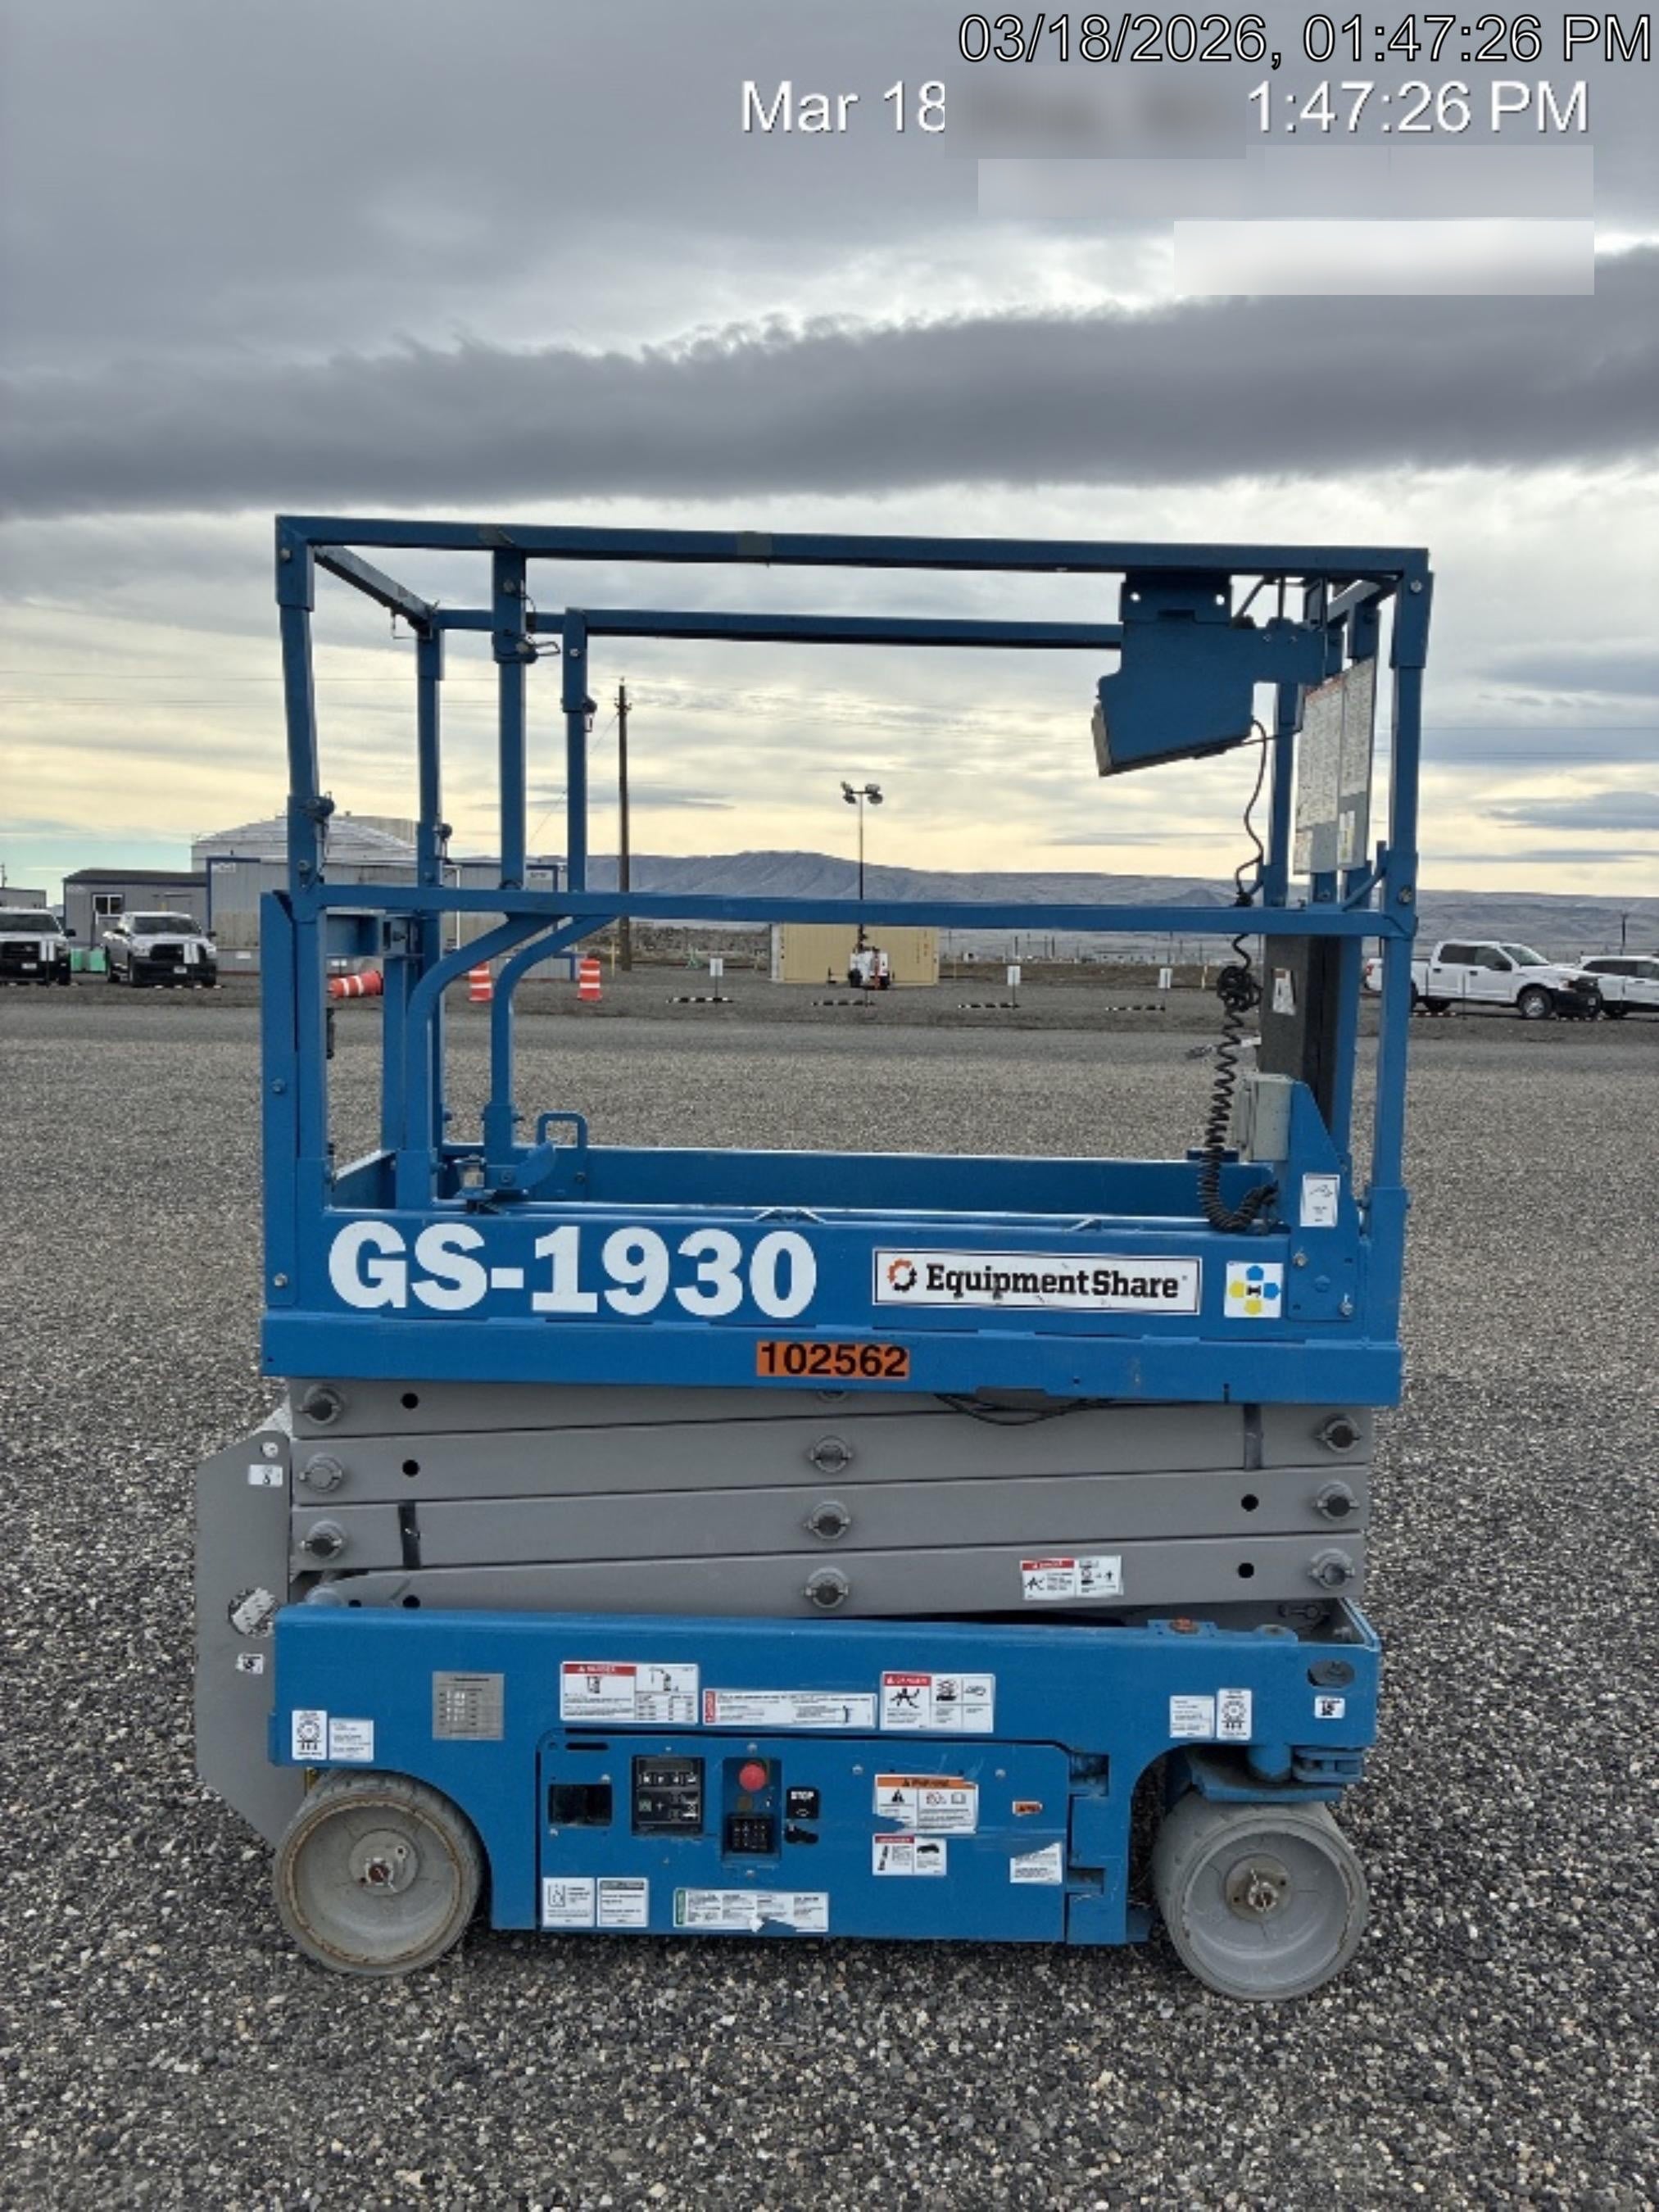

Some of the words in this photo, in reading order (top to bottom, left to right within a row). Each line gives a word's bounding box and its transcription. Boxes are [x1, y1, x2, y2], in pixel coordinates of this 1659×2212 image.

[328, 1220, 818, 1319] GS-1930
[926, 1262, 1179, 1300] EquipmentShare
[761, 1341, 908, 1377] 102562
